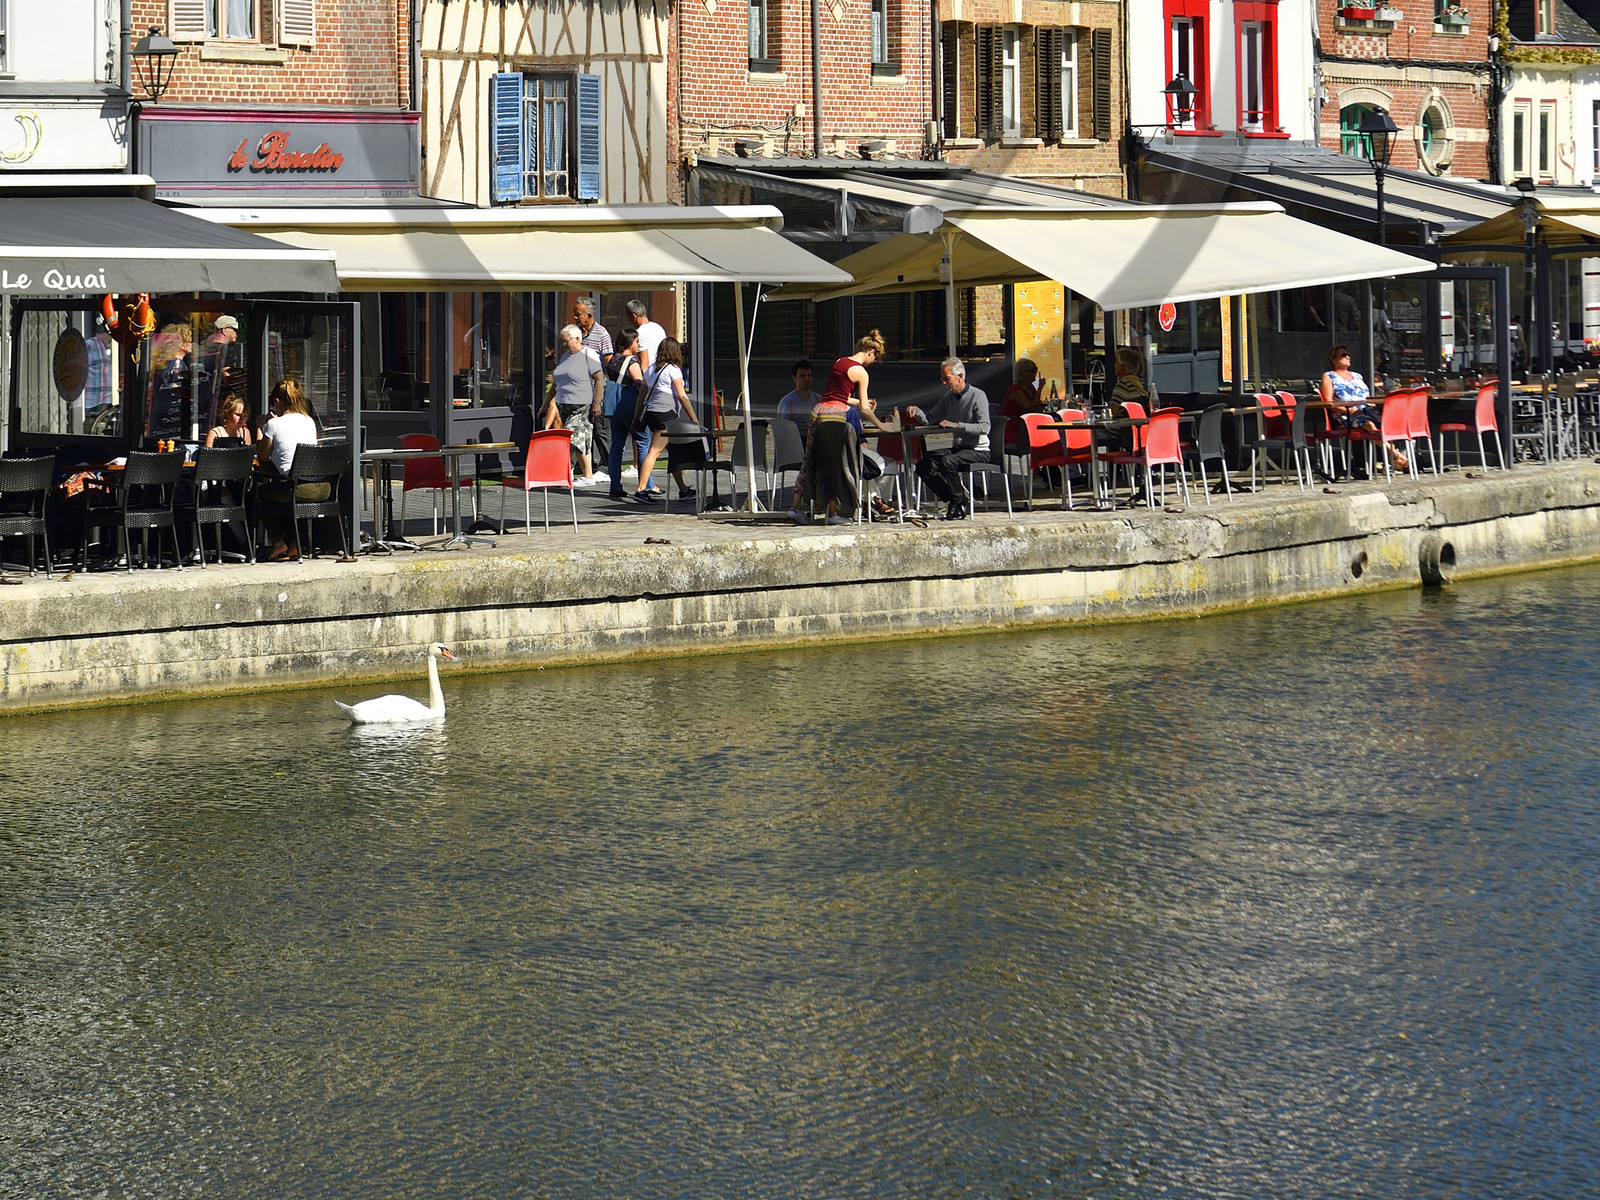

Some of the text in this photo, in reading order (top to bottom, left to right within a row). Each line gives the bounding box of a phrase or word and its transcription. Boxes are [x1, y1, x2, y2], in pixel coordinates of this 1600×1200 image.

[230, 131, 345, 170] le Baratin
[2, 268, 107, 291] Le Quai
